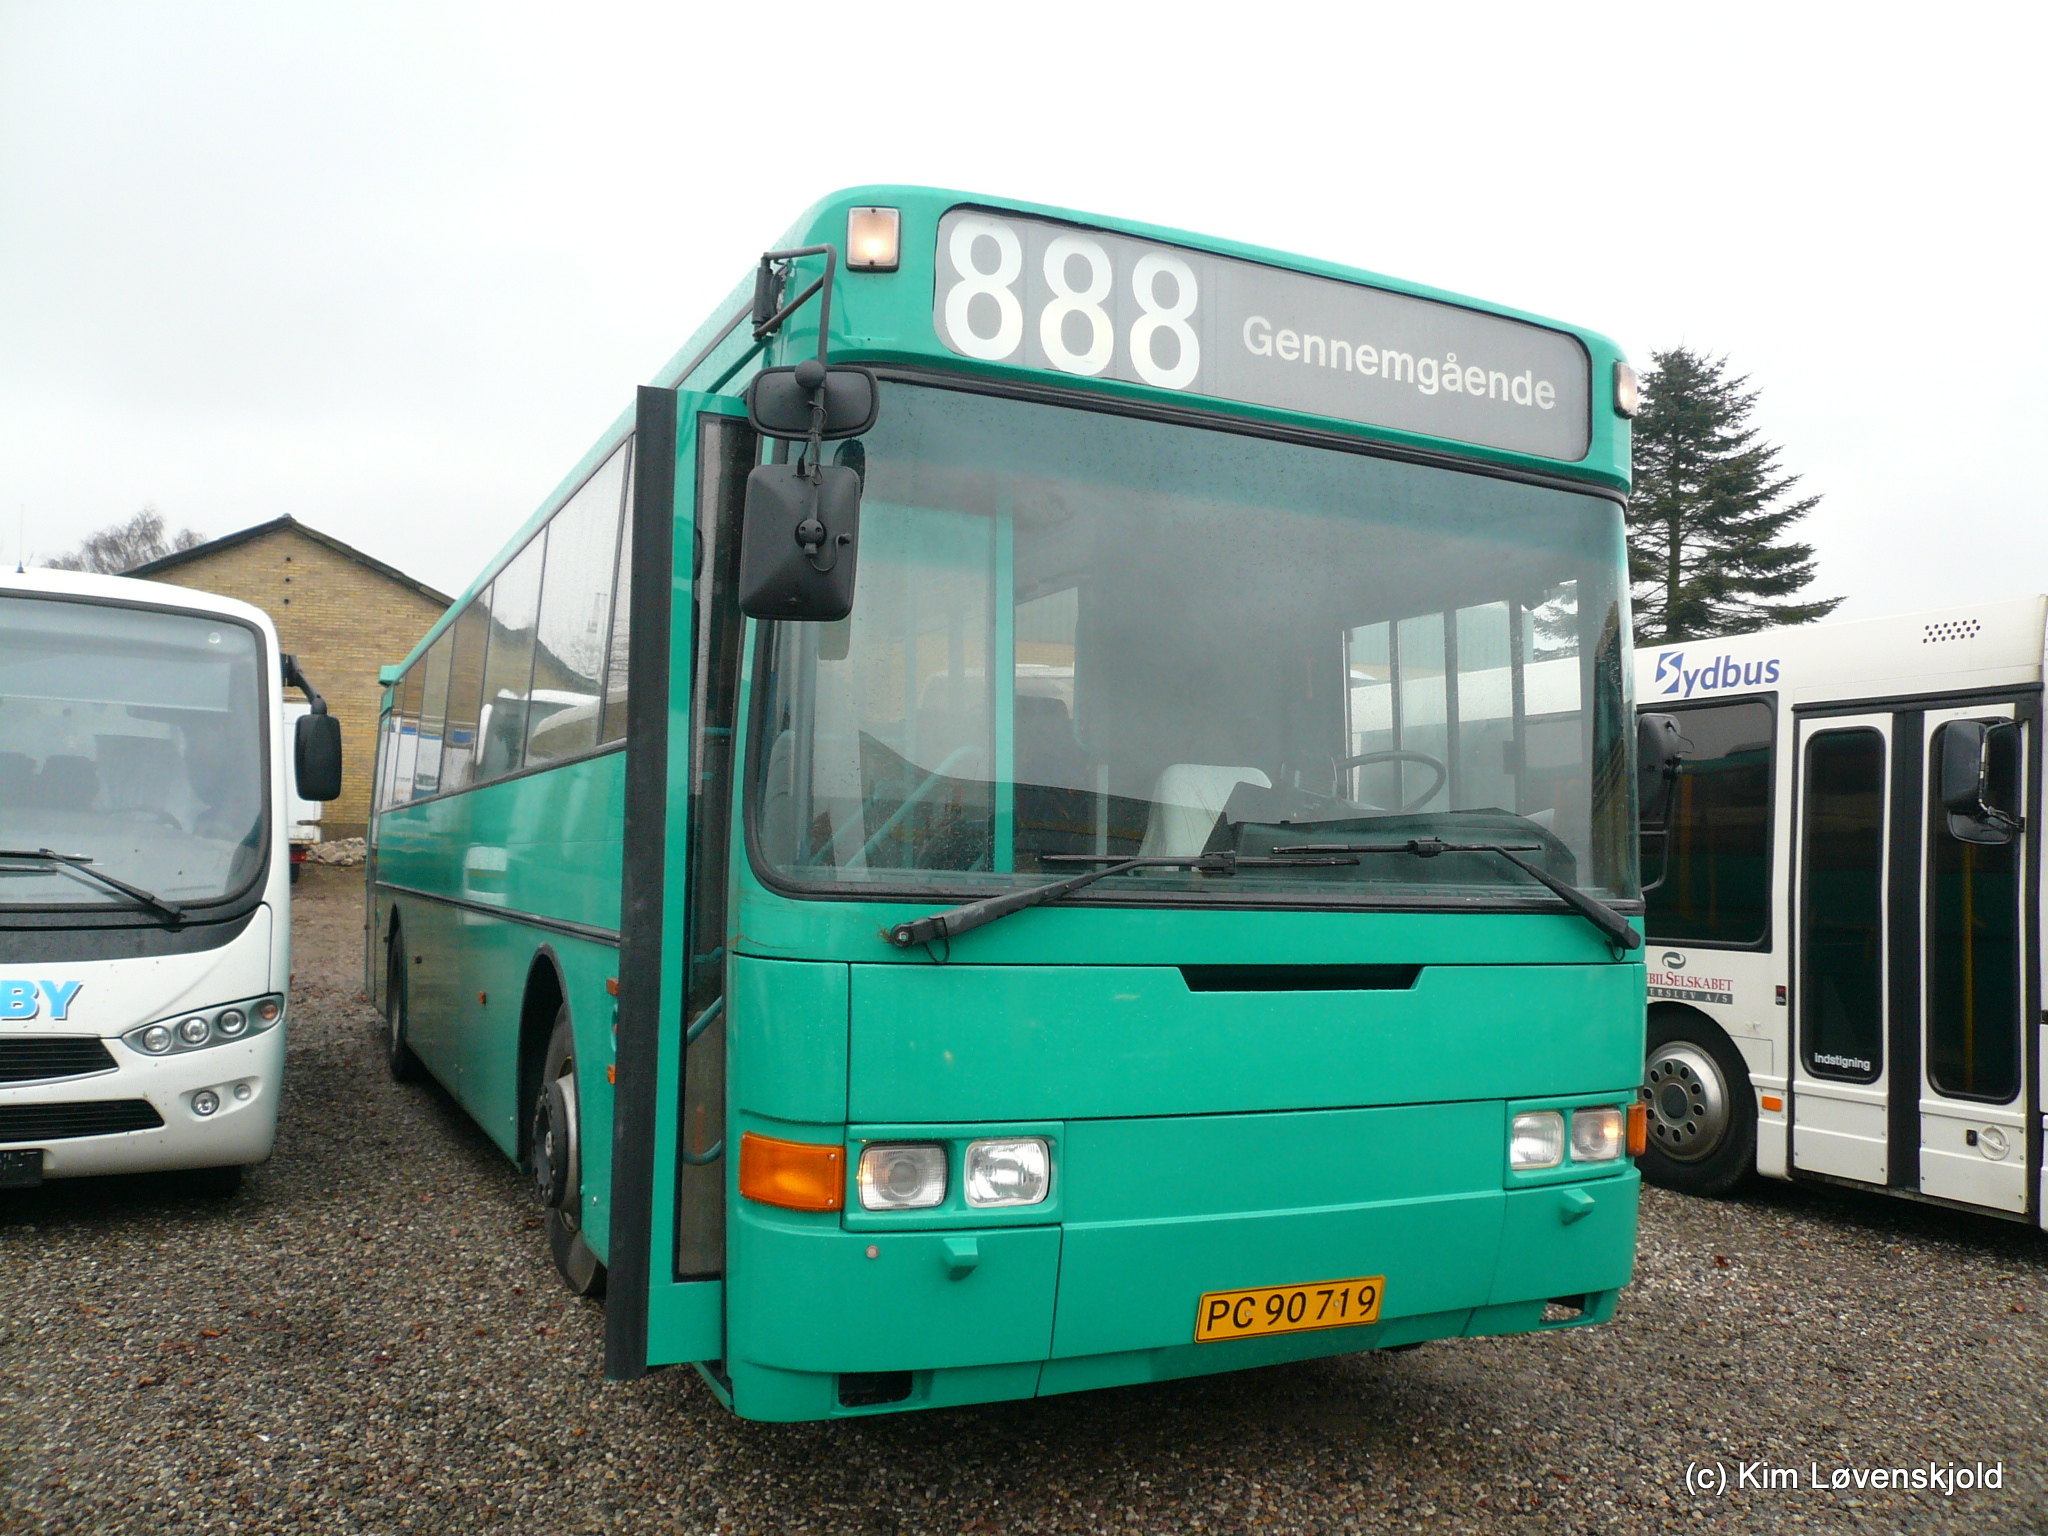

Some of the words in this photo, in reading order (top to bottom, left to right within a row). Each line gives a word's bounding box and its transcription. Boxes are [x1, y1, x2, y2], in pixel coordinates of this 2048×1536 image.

[944, 217, 1200, 390] 888
[1242, 315, 1556, 410] Gennemgående
[1655, 651, 1780, 698] Sydbus
[1646, 972, 1733, 991] BILSELSKABET
[1649, 987, 1697, 1000] ERSLEV
[1704, 993, 1729, 1003] A/S
